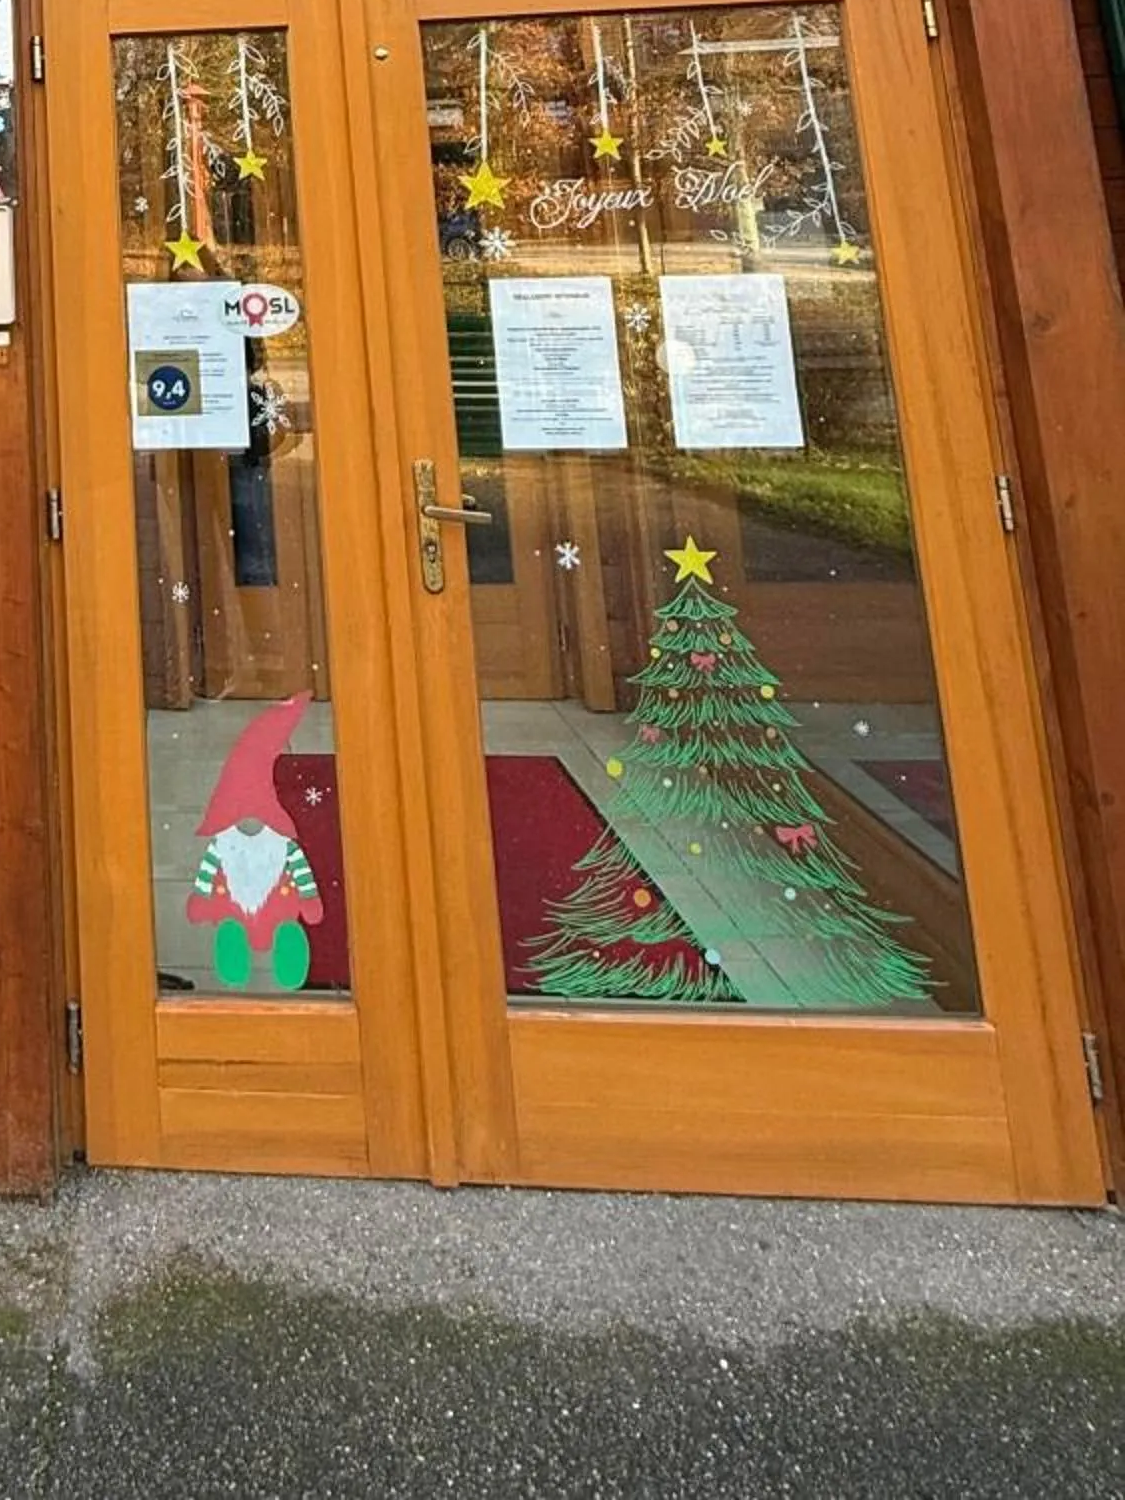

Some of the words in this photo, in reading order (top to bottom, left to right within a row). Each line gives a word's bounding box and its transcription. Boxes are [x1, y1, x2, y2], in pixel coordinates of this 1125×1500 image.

[530, 177, 654, 229] Joyeux
[224, 293, 296, 317] MOSL
[152, 379, 186, 400] 9,4
